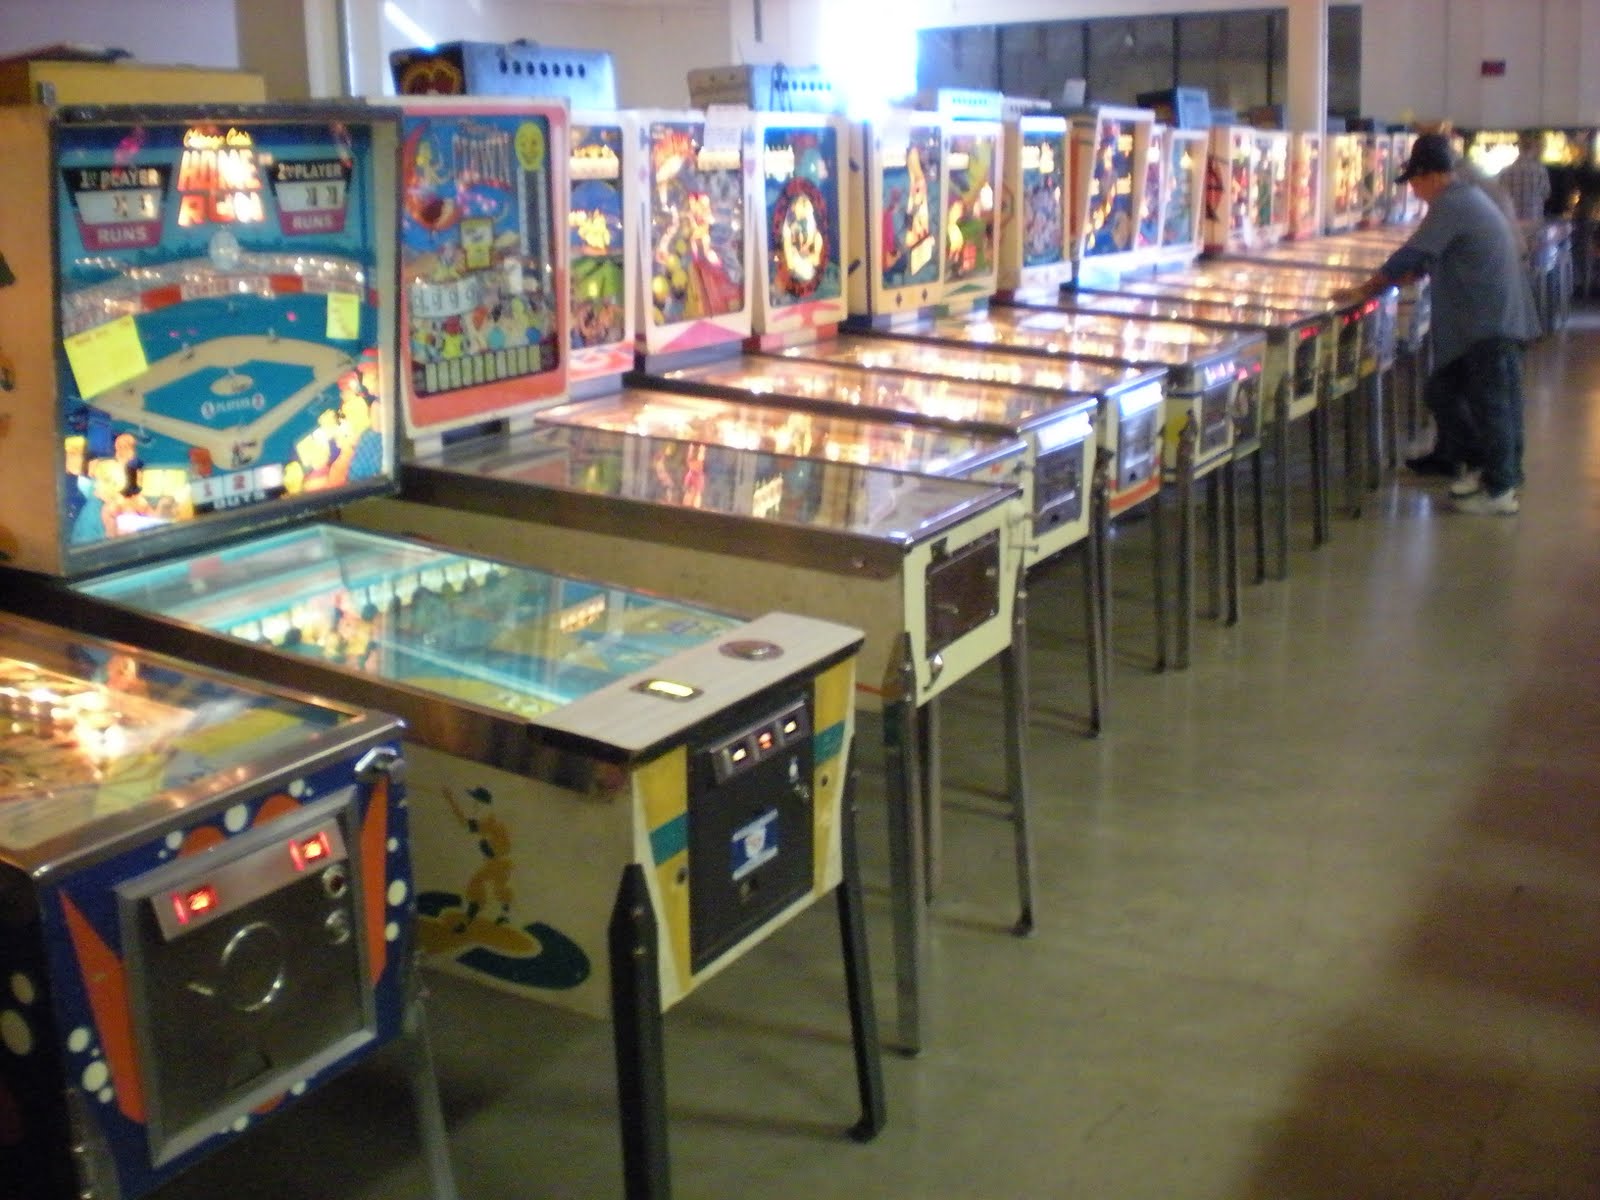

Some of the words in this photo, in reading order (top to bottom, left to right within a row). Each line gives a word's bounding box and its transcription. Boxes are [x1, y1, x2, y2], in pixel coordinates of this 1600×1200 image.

[178, 149, 262, 191] HOME
[178, 191, 265, 227] RUN
[292, 214, 334, 229] RUNS
[97, 226, 147, 243] RUNS
